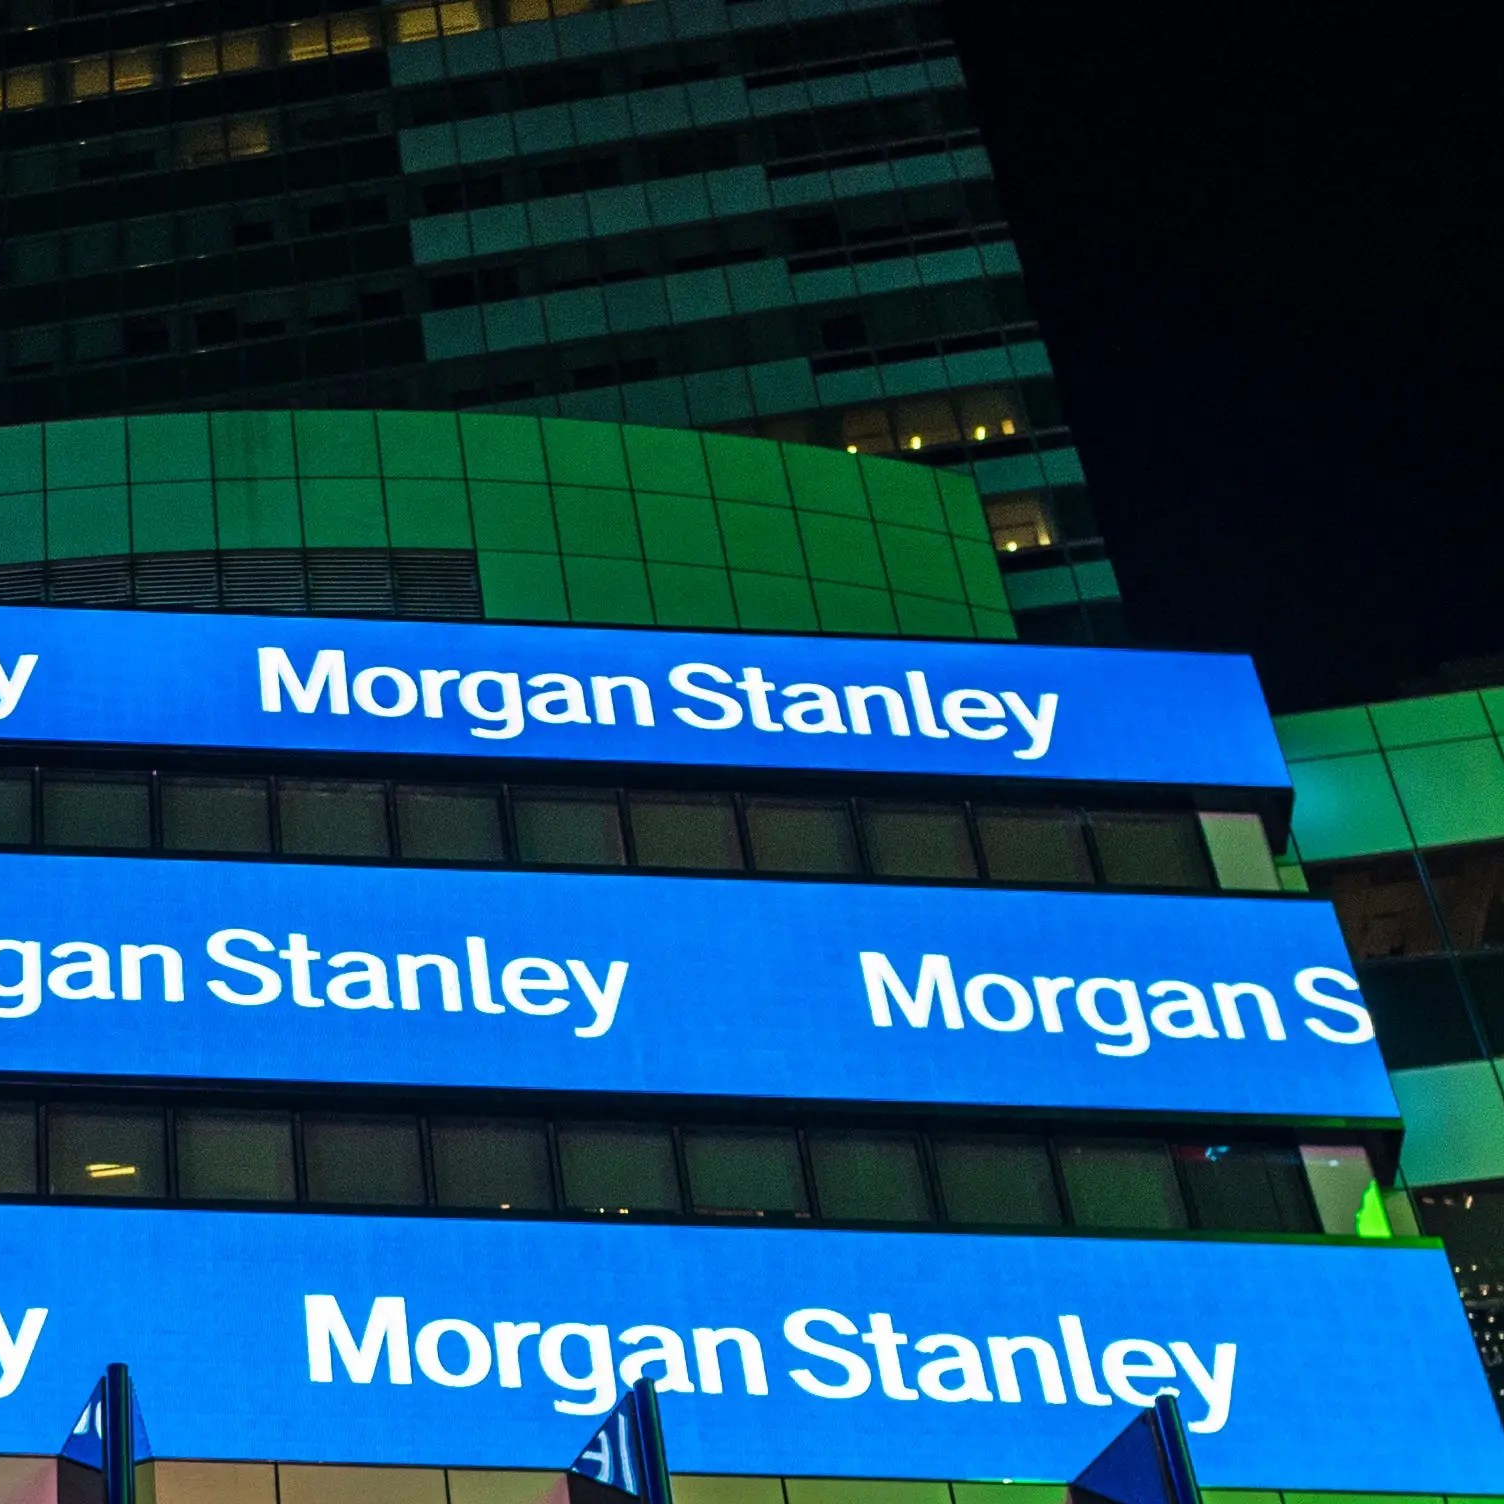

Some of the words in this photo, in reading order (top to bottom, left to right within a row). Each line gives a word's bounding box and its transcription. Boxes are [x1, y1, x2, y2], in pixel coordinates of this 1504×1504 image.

[258, 647, 654, 739] Morgan
[669, 663, 1058, 759] Stanley
[207, 929, 628, 1037] Stanley
[860, 952, 1286, 1056] Morgan
[305, 1295, 768, 1415] Morgan
[784, 1309, 1236, 1433] Stanley
